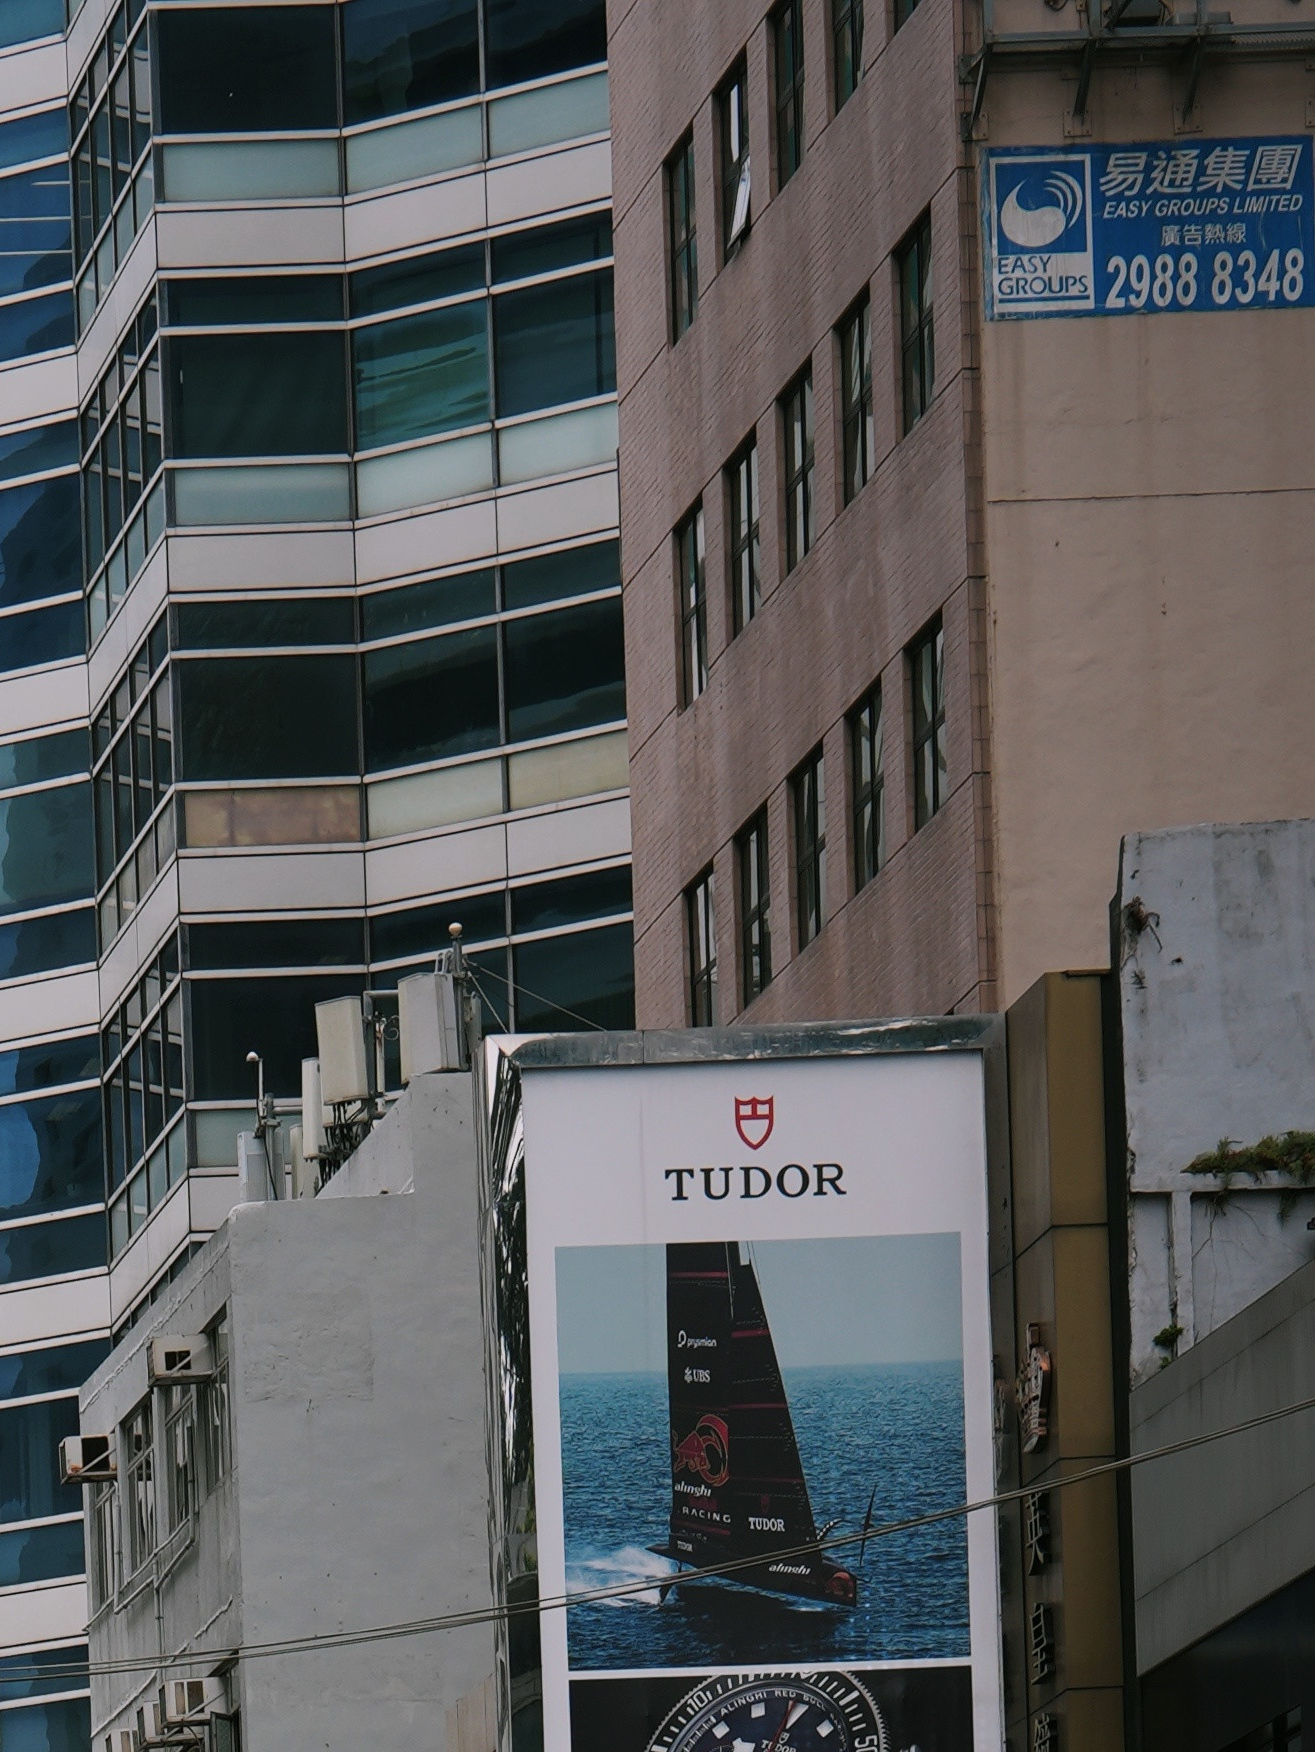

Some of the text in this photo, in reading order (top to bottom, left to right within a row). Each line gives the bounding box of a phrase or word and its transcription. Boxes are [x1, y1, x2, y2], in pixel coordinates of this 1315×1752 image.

[1099, 143, 1304, 198] 易通集團
[1102, 194, 1303, 219] EASY GROUPS LIMITED
[1160, 222, 1247, 247] 廣告熱線
[997, 255, 1052, 275] EASY
[997, 274, 1089, 296] GROUPS
[1104, 247, 1305, 309] 2988 8348
[664, 1162, 847, 1201] TUDOR
[692, 1368, 711, 1382] UBS
[674, 1481, 712, 1497] alinghi
[681, 1505, 732, 1523] RACING
[747, 1516, 785, 1532] TUDOR
[721, 1691, 768, 1716] ALINGHI
